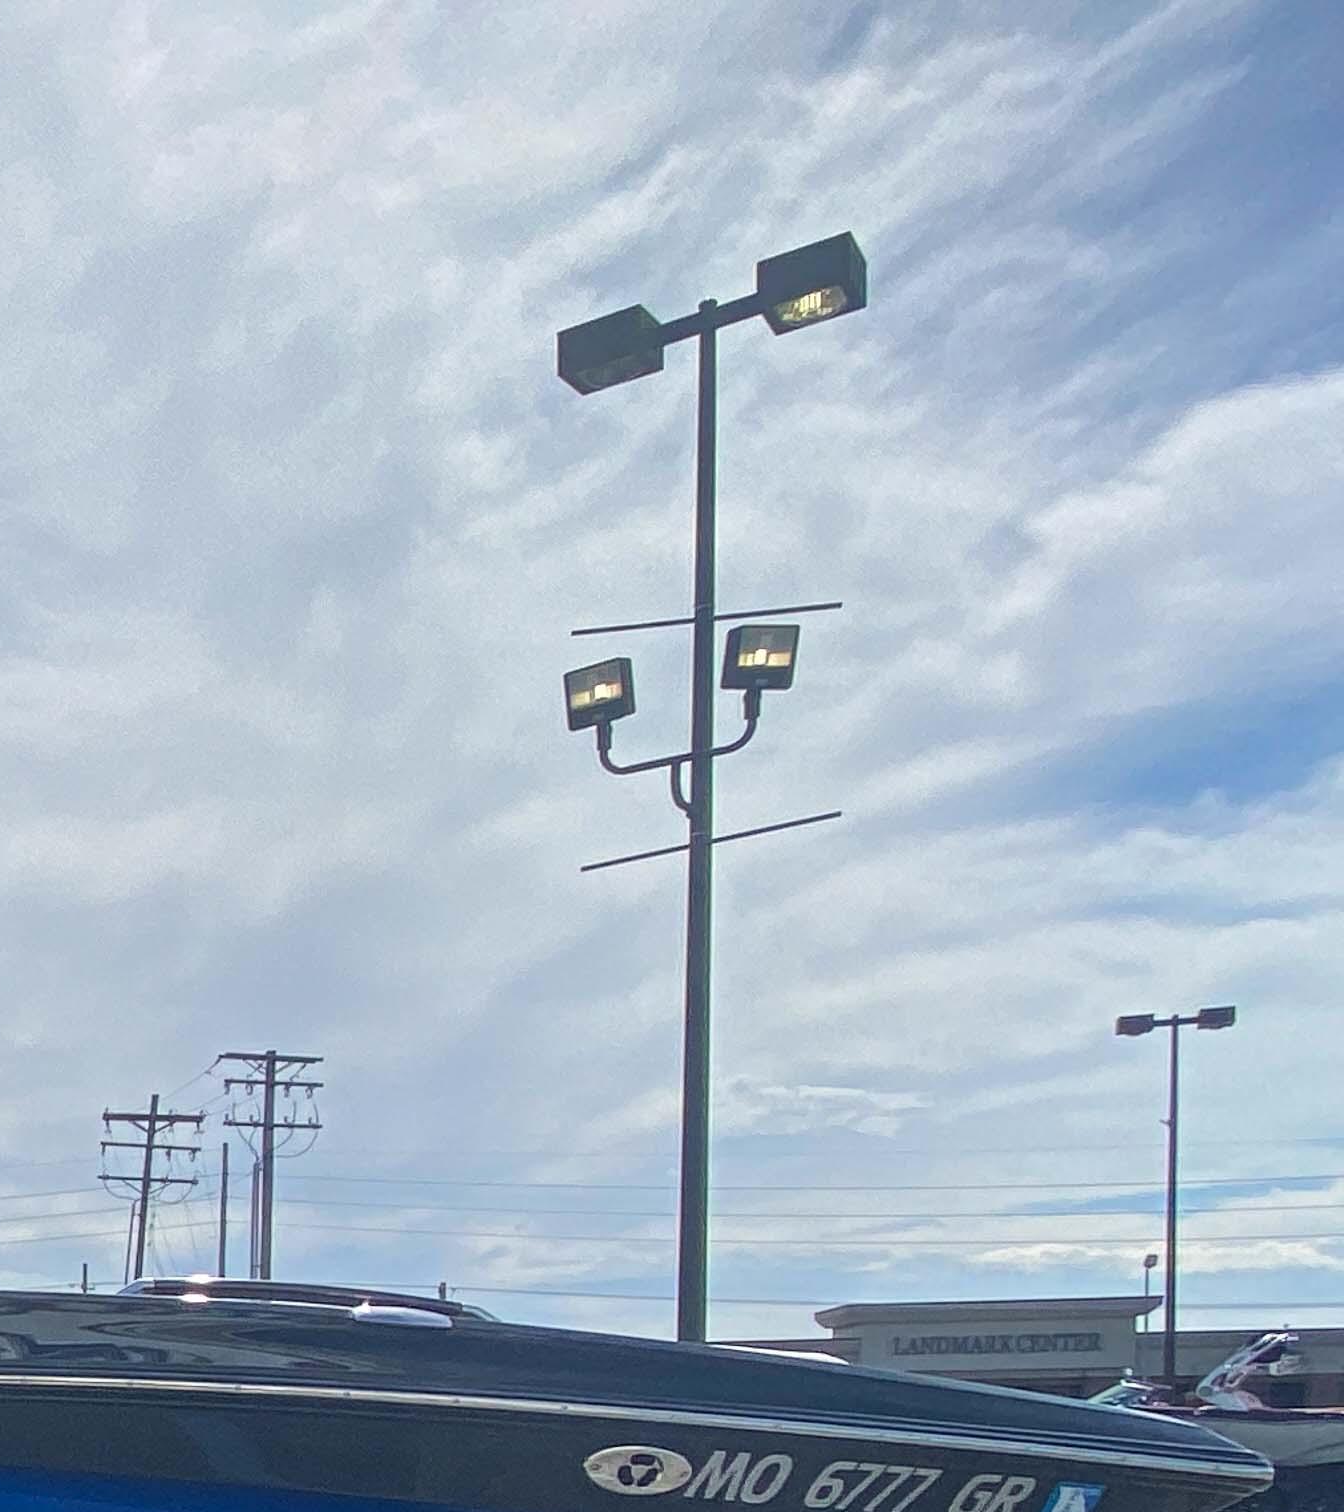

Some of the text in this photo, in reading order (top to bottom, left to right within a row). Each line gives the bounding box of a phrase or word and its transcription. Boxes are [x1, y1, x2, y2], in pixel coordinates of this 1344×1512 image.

[893, 1332, 1102, 1356] LANDMARK CENTER
[684, 1450, 793, 1504] MO
